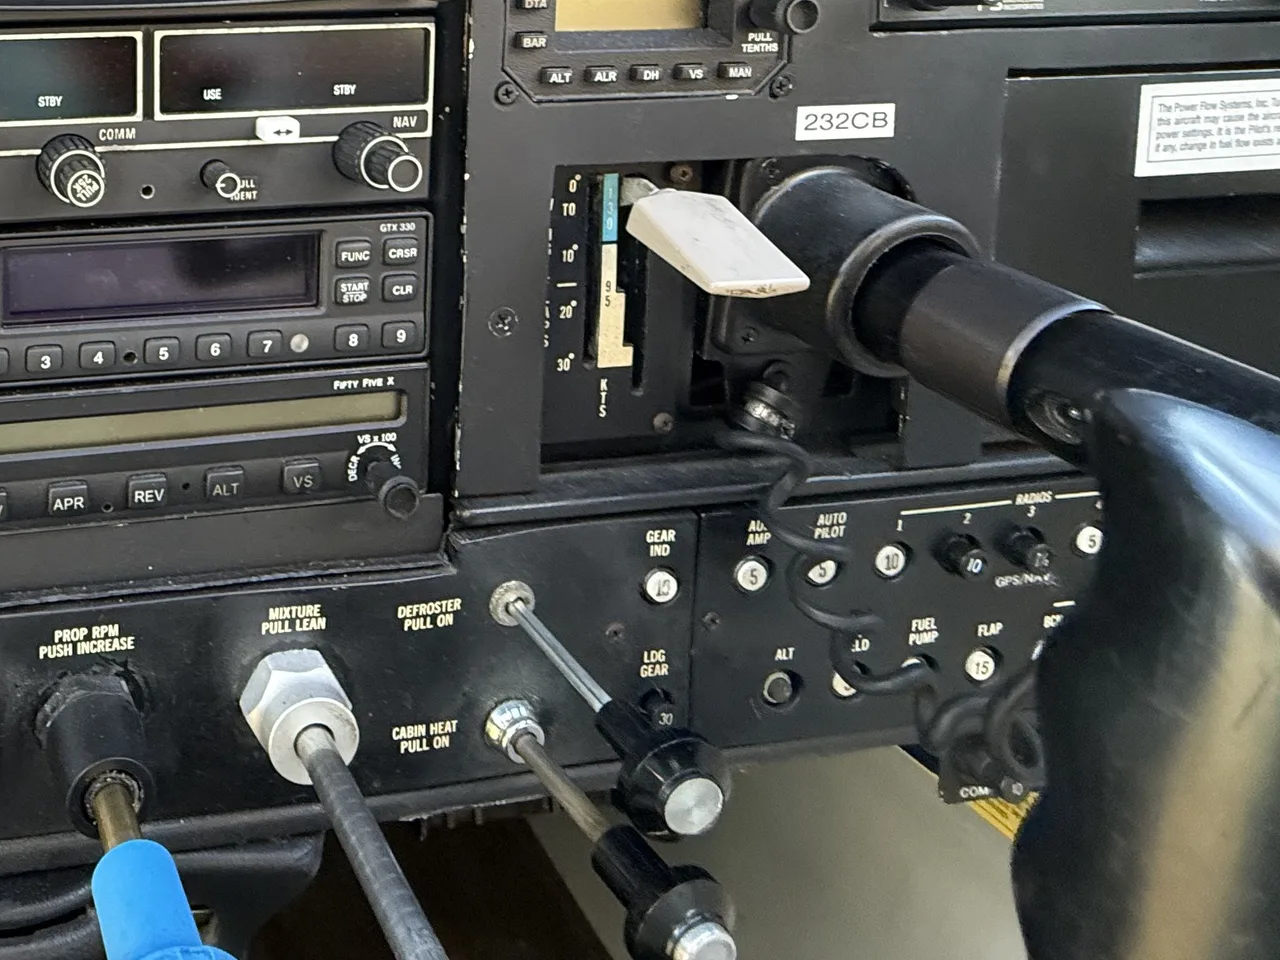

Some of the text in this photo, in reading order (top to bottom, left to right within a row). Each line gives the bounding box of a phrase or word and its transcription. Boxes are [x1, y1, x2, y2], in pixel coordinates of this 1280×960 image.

[523, 36, 546, 48] BAR
[748, 33, 772, 42] PULL
[741, 42, 779, 53] TENTHS
[550, 72, 571, 84] ALT
[595, 70, 616, 83] ALR
[729, 67, 752, 78] MAN
[38, 96, 62, 107] STBY
[1158, 103, 1172, 112] The
[393, 116, 417, 128] NAV
[804, 111, 888, 131] 232CB
[99, 128, 136, 140] COMM
[380, 223, 416, 232] GTX 330
[341, 251, 370, 261] FUNC
[389, 248, 417, 258] CRSR
[341, 282, 369, 292] START
[393, 285, 413, 296] CLR
[343, 293, 367, 303] STOP
[334, 376, 394, 390] FIFTY FIVE X
[134, 489, 165, 503] REV
[213, 483, 239, 496] ALT
[53, 496, 84, 511] APR
[1016, 491, 1053, 505] RADIOS
[817, 512, 847, 526] AUTO
[646, 530, 676, 543] GEAR
[814, 525, 846, 539] PILOT
[746, 533, 771, 545] AMP
[650, 544, 670, 556] IND
[269, 604, 321, 620] MIXTURE
[397, 598, 461, 619] DEFROSTER
[261, 617, 326, 635] PULL LEAN
[404, 613, 454, 631] PULL ON
[912, 617, 937, 631] FUEL
[54, 624, 119, 643] PROP RPM
[978, 622, 1003, 636] FLAP
[909, 632, 939, 645] PUMP
[39, 637, 135, 659] PUSH INCREASE
[775, 647, 795, 660] ALT
[643, 650, 666, 663] LDG
[640, 664, 668, 678] GEAR
[392, 720, 458, 741] CABIN HEAT
[400, 736, 449, 754] PULL ON
[959, 786, 990, 798] COM
